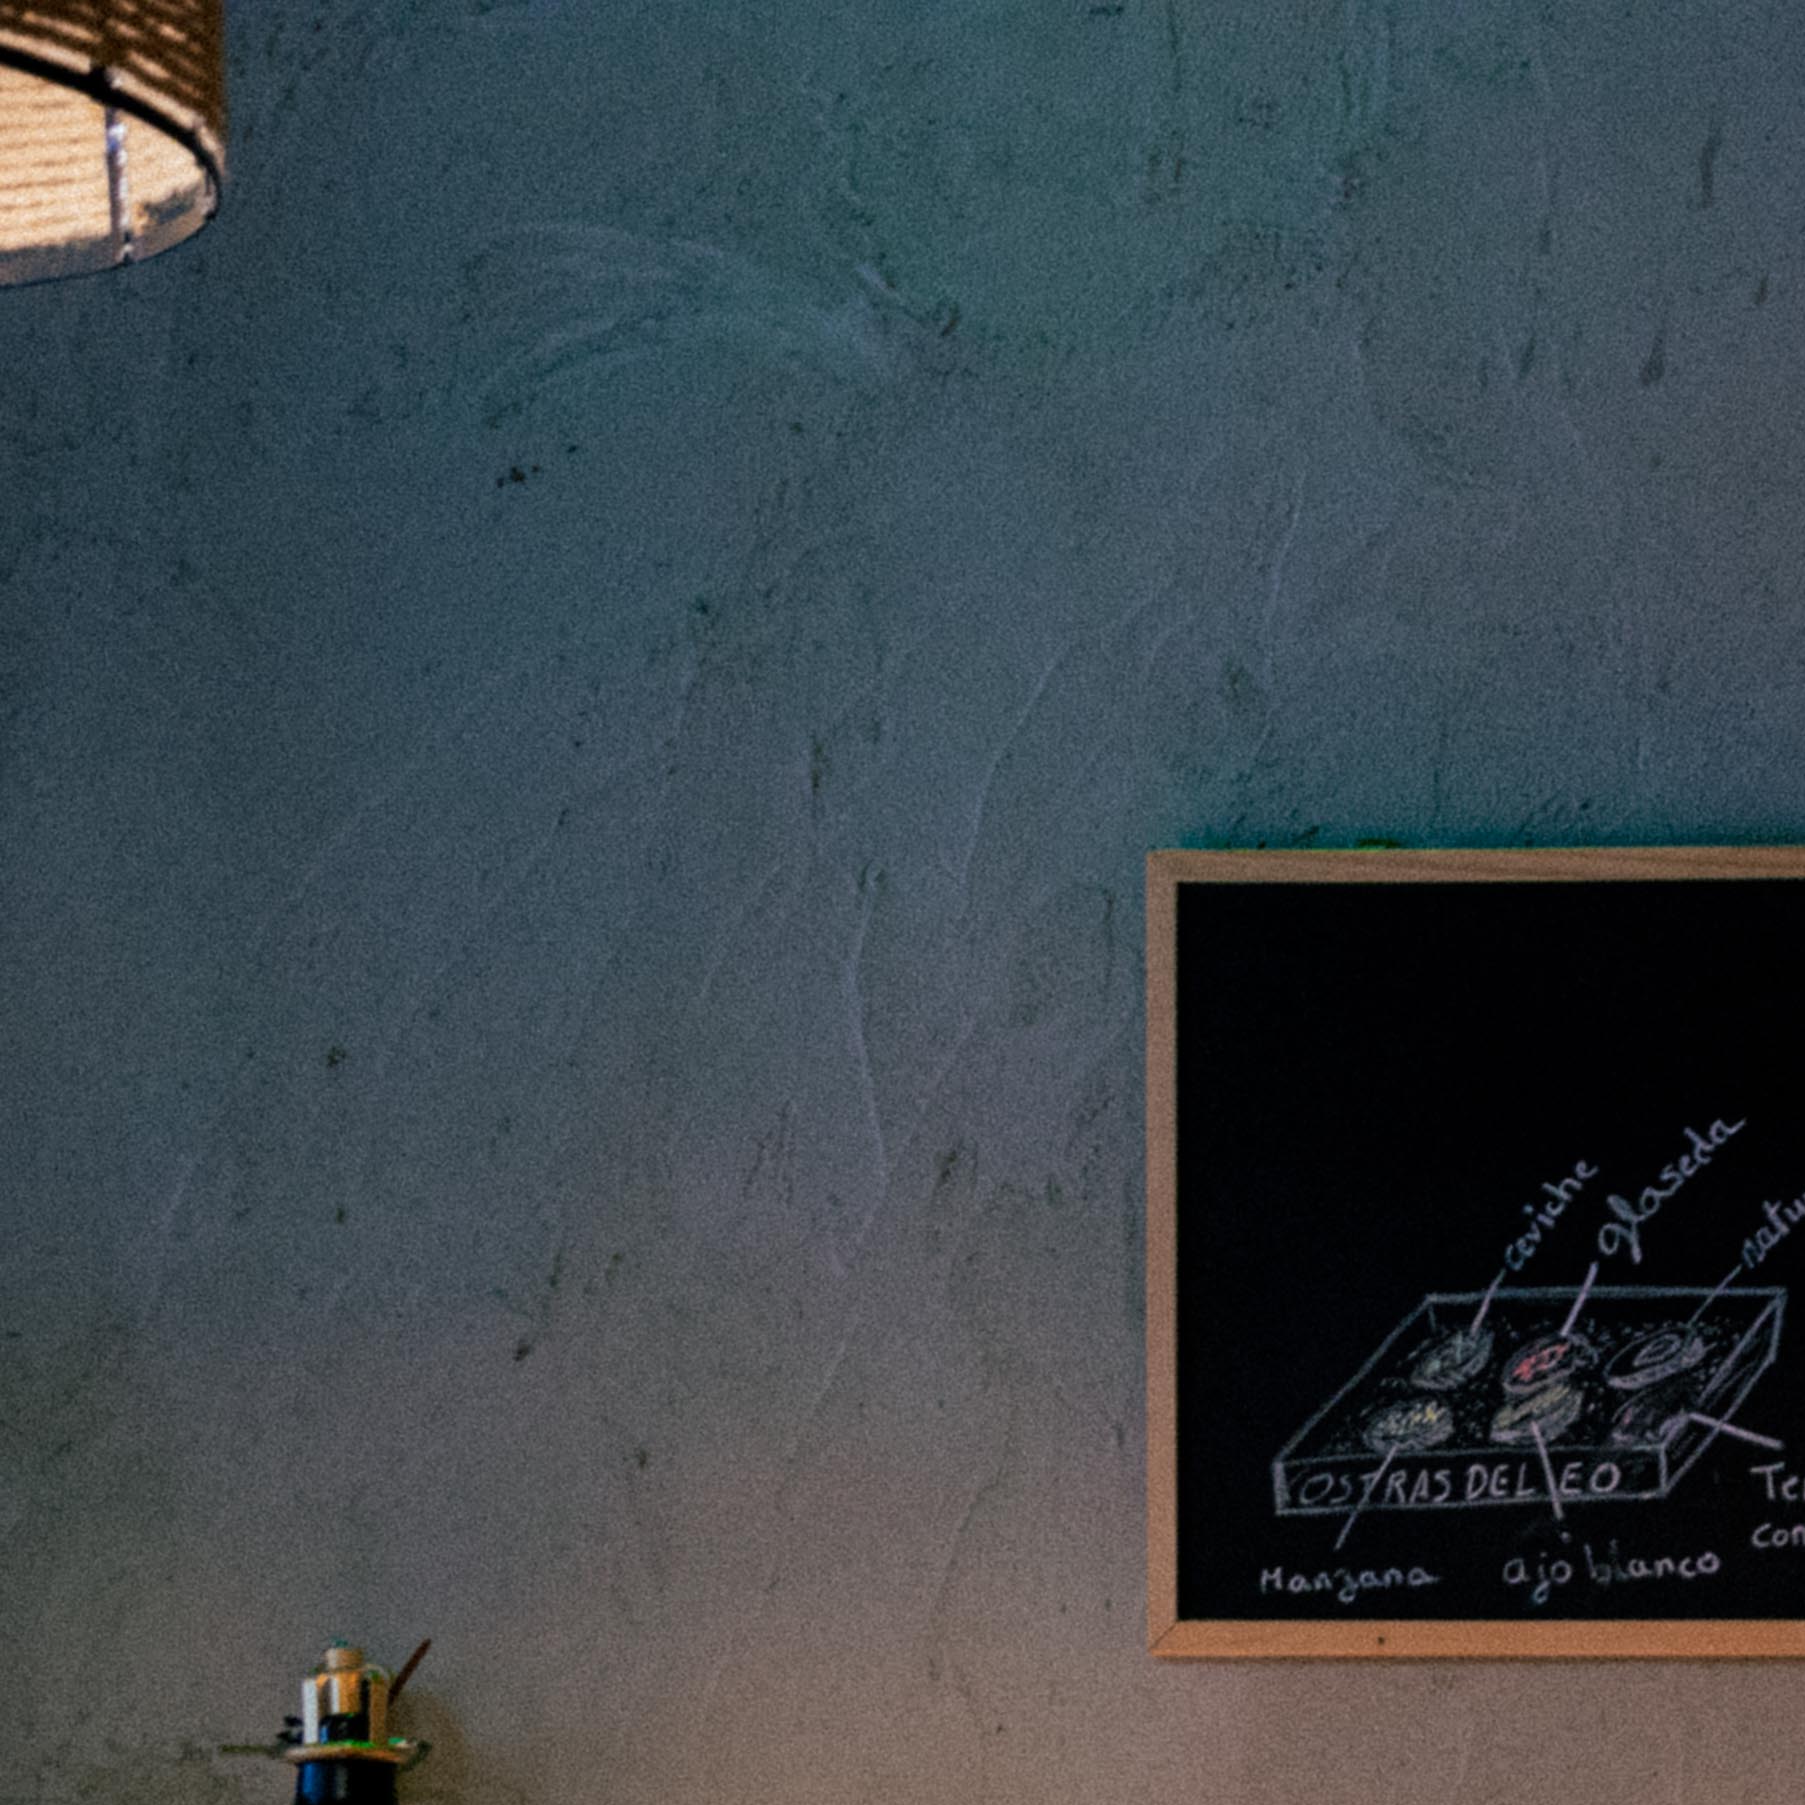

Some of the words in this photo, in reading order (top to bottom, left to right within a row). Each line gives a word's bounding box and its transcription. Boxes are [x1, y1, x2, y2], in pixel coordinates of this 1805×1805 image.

[1504, 1158, 1599, 1272] ceviche
[1302, 1467, 1453, 1504] OSTRAS
[1464, 1463, 1537, 1501] DEL
[1257, 1565, 1443, 1605] Manzana
